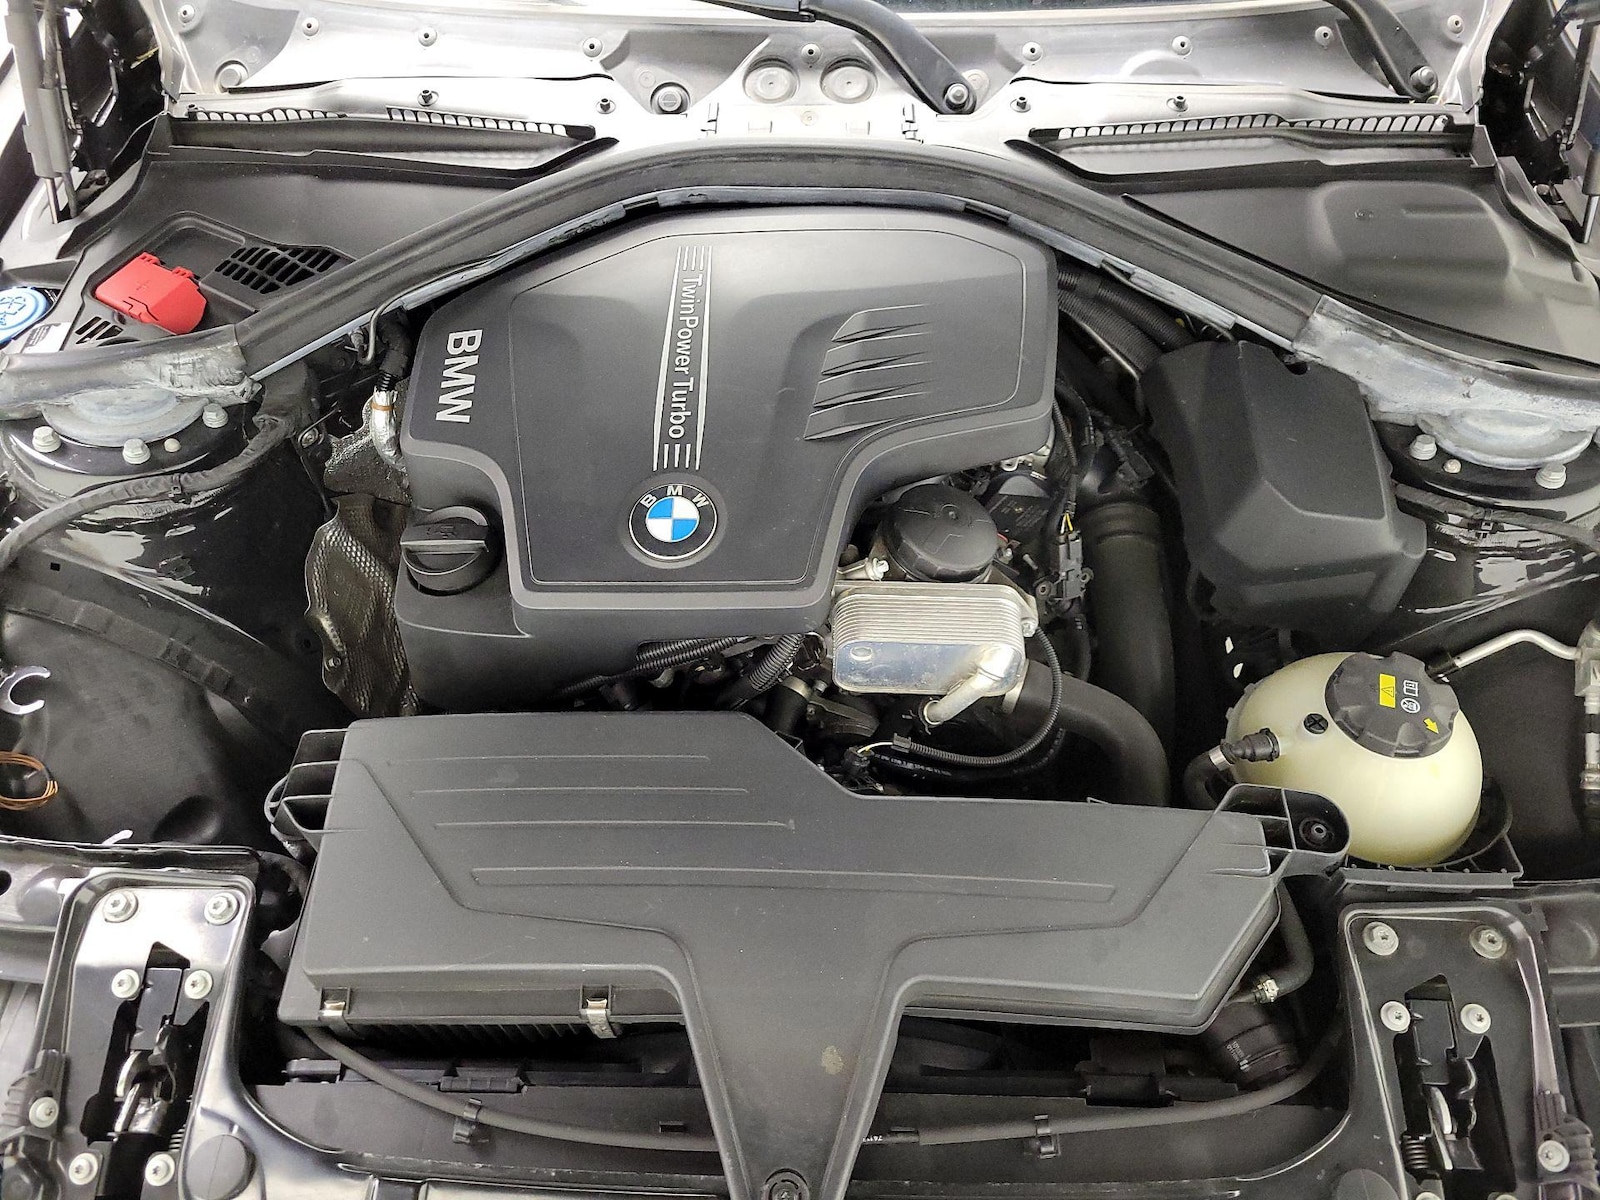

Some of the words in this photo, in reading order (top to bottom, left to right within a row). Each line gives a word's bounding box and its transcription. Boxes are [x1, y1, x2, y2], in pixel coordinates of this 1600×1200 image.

[674, 273, 703, 375] TwinPower
[435, 329, 483, 423] BMW
[668, 376, 694, 439] Turbo
[640, 485, 710, 508] BMW
